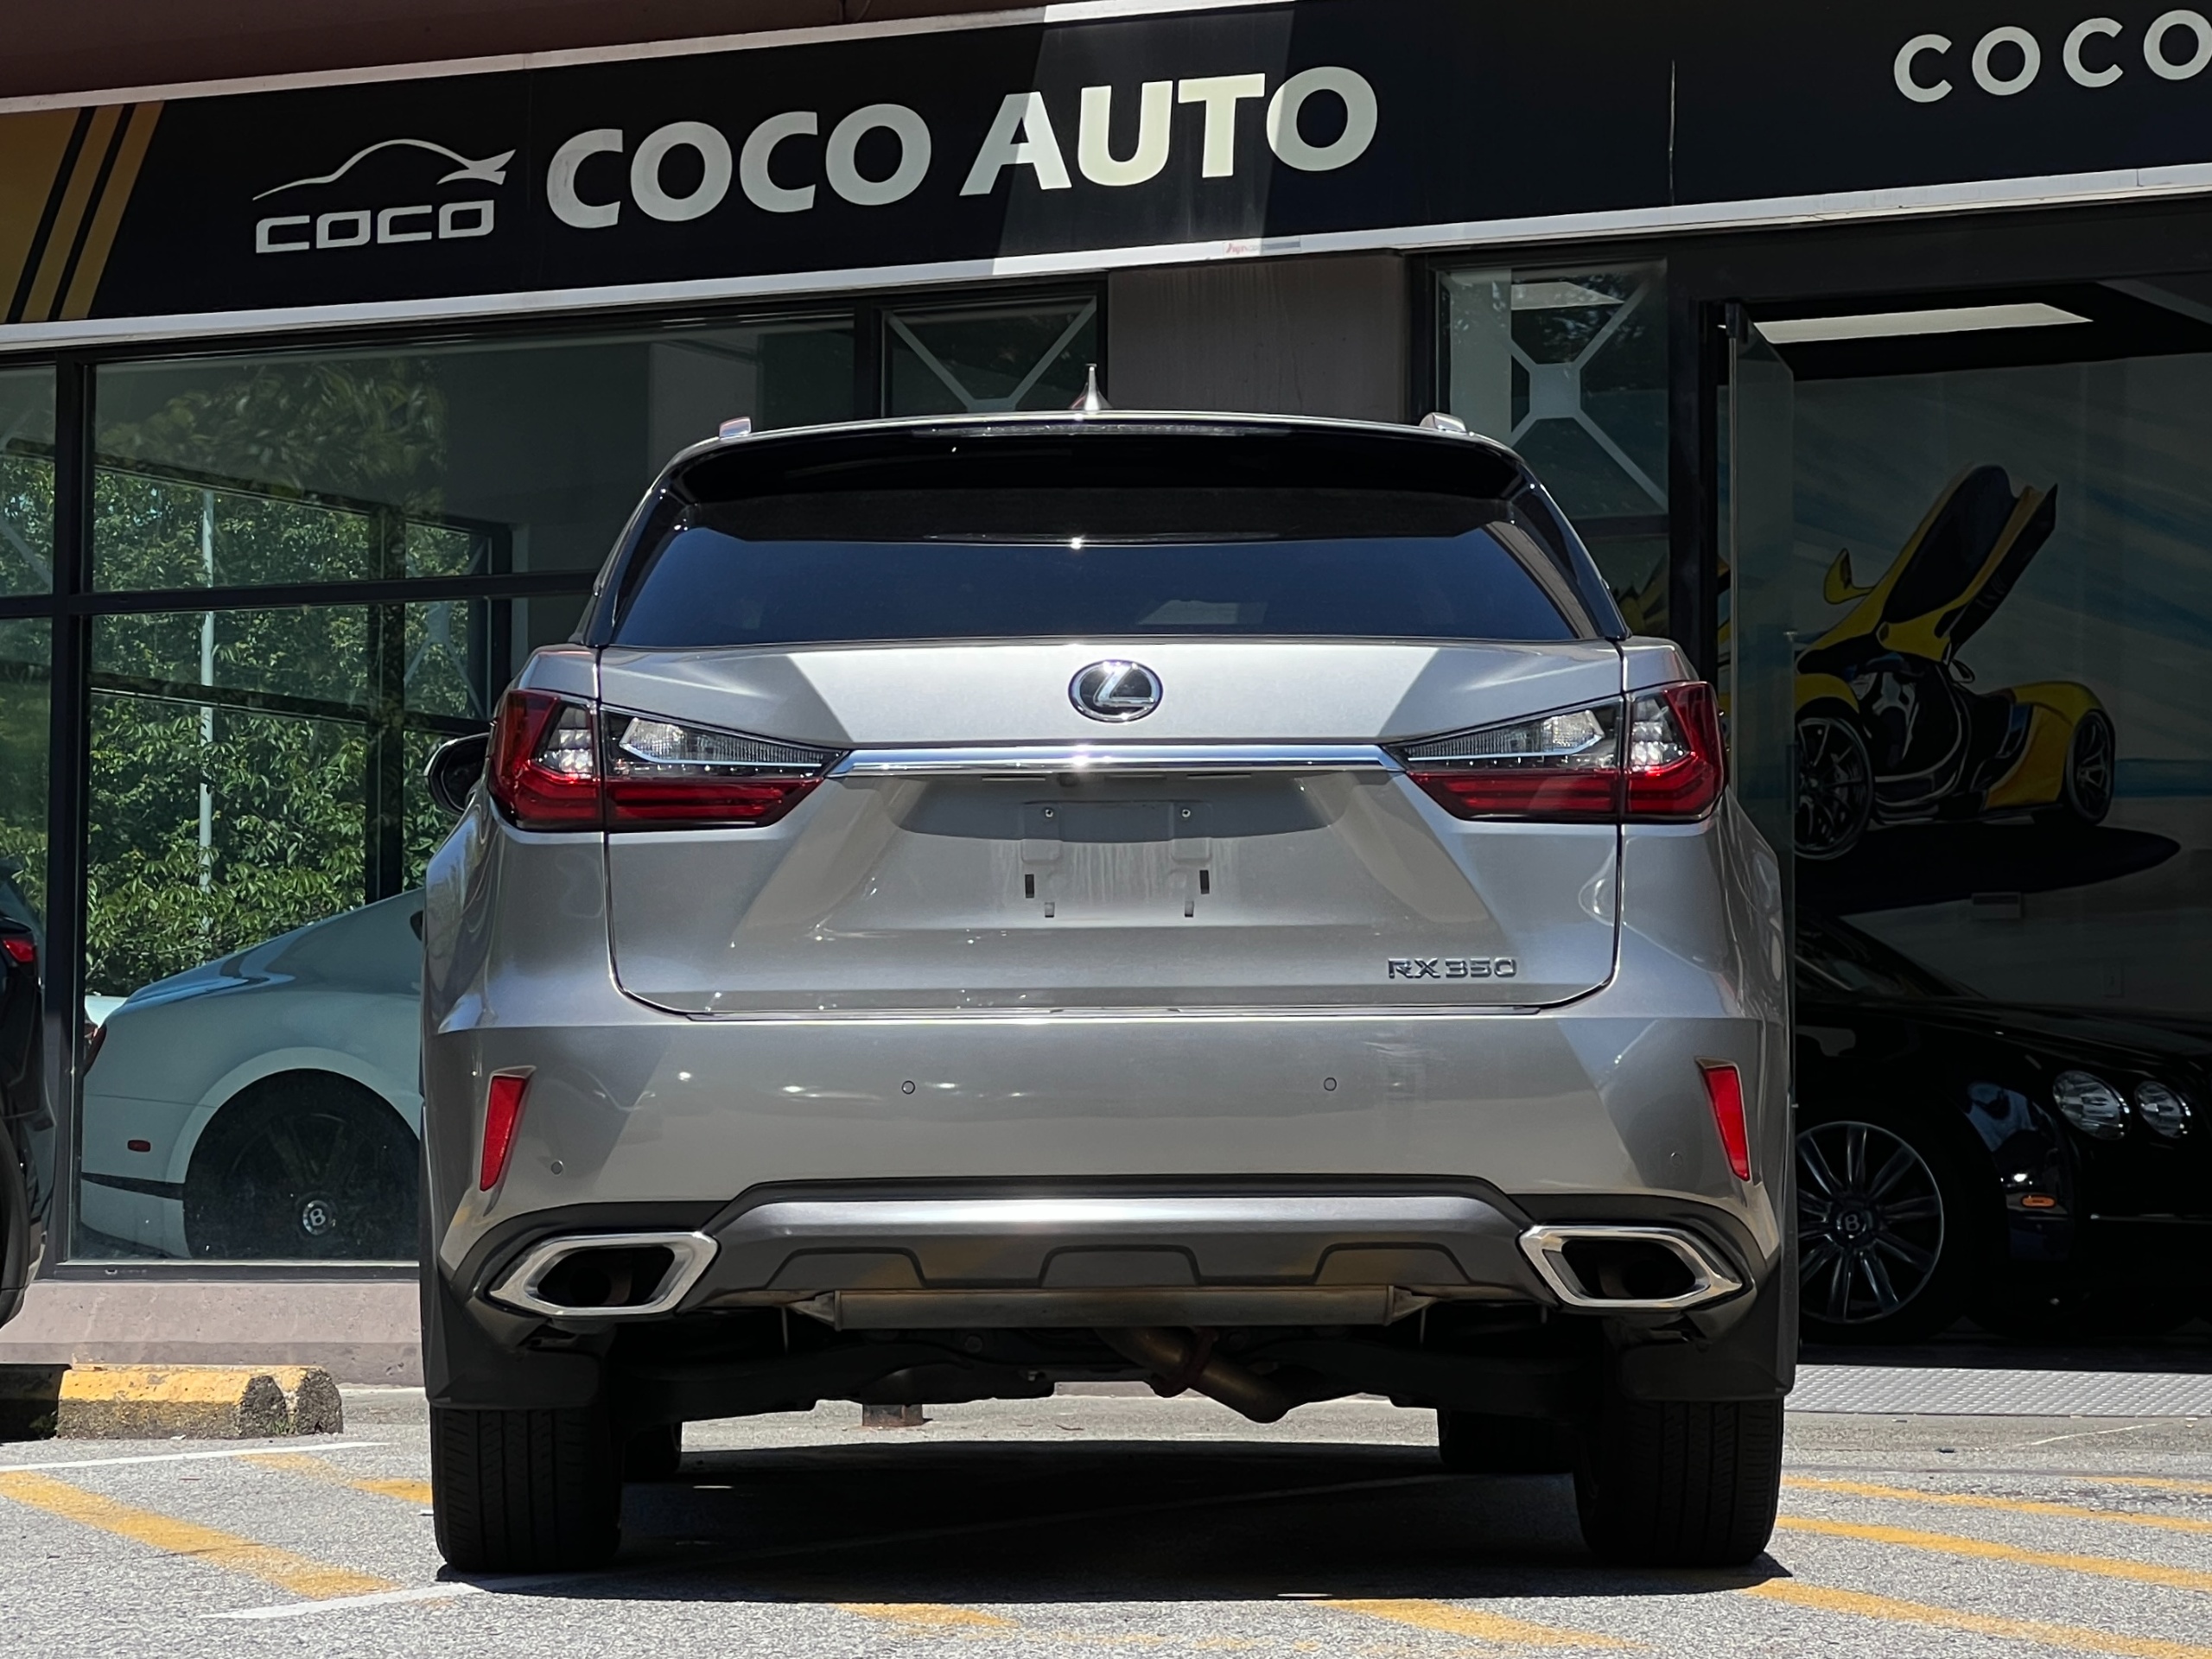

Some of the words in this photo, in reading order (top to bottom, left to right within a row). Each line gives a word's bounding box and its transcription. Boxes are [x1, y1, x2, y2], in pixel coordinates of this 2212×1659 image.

[1893, 10, 2212, 103] COCO
[546, 103, 932, 229] COCO
[959, 66, 1378, 196] AUTO
[255, 200, 495, 253] COCO
[1388, 957, 1440, 979] RX
[1445, 957, 1516, 978] 350
[310, 1208, 326, 1226] B
[1845, 1214, 1860, 1231] B
